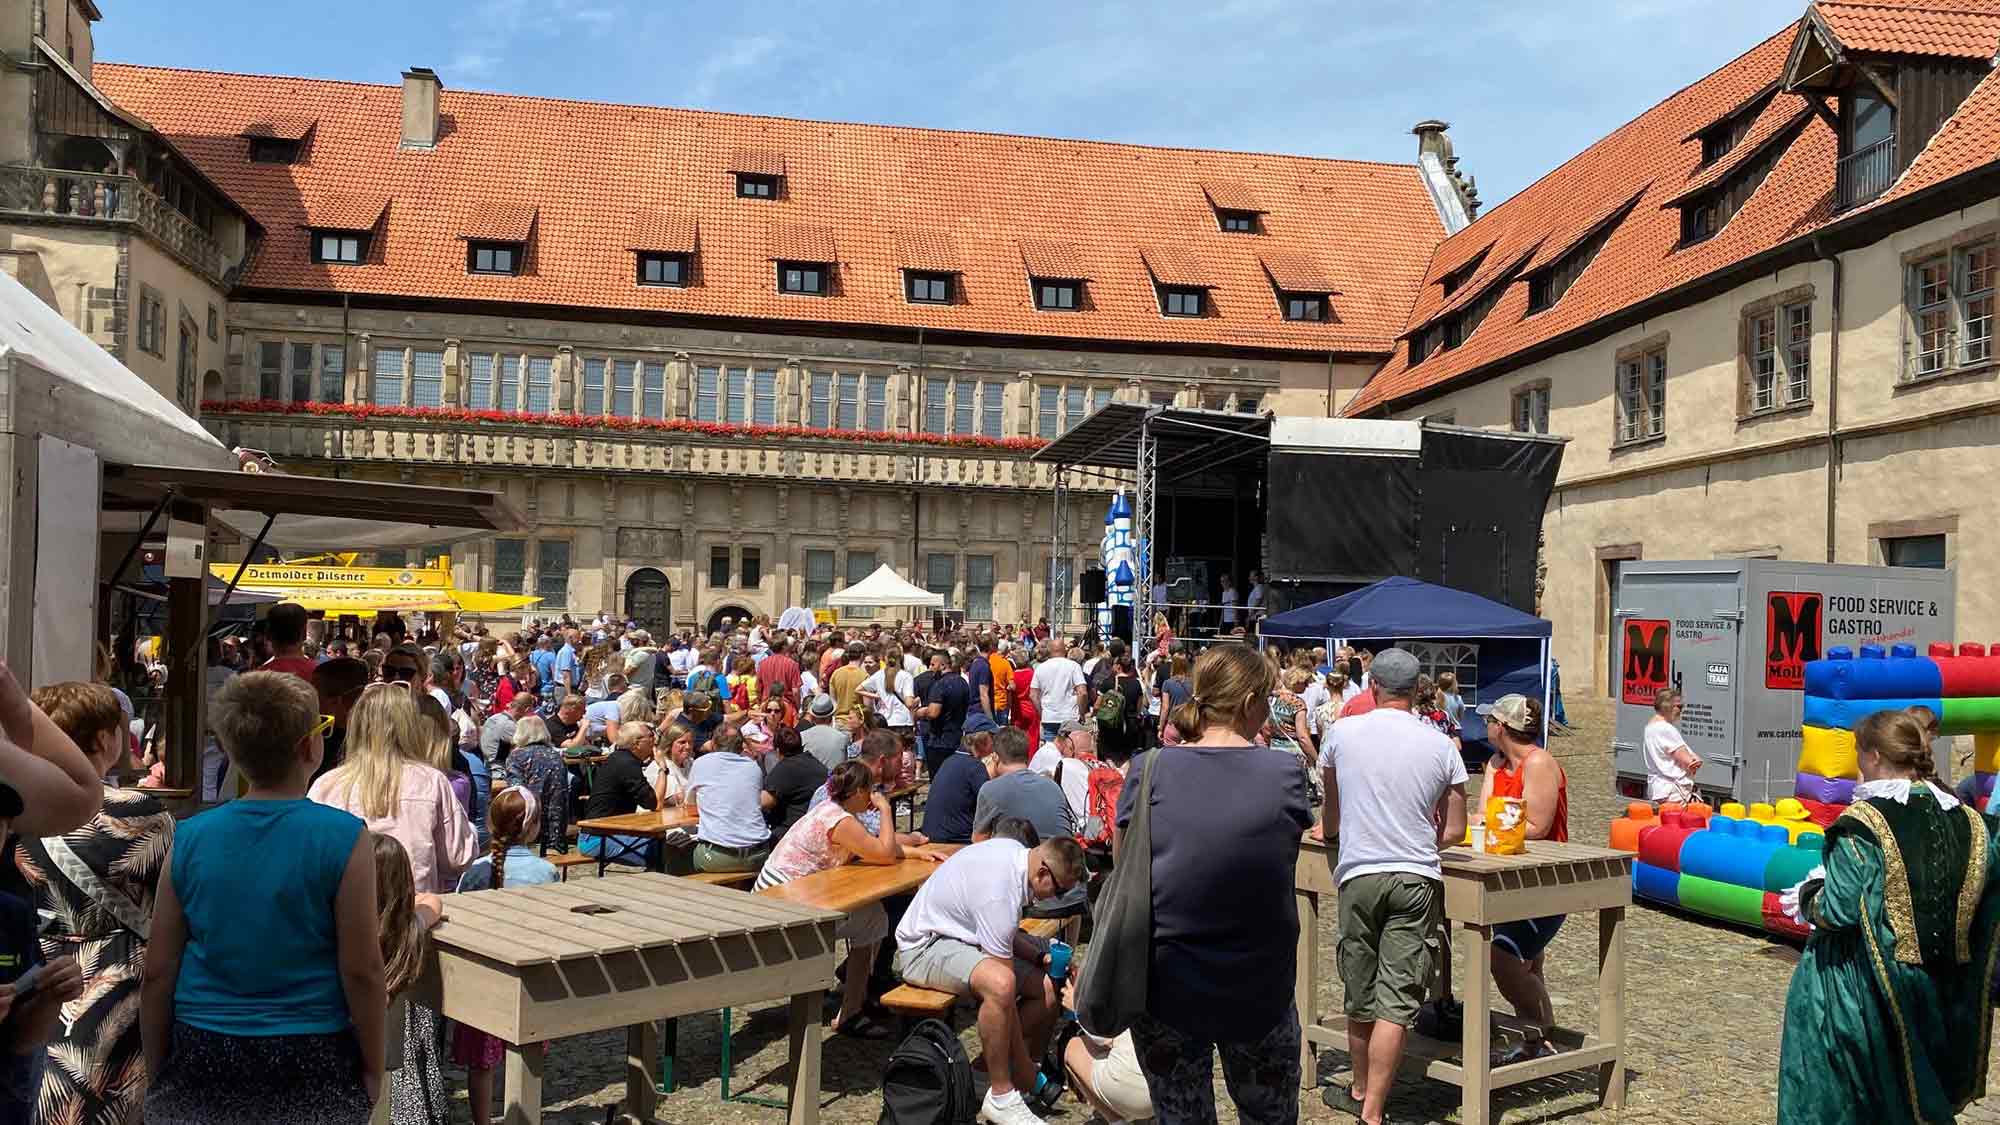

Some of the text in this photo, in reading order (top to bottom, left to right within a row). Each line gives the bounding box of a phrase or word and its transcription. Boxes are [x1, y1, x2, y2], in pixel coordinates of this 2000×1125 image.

[249, 569, 365, 582] Detmolder Pilsener
[1829, 597, 1938, 616] FOOD SERVICE &
[1676, 619, 1732, 630] FOOD SERVICE &
[1768, 596, 1820, 661] M
[1829, 619, 1882, 635] GASTRO
[1676, 630, 1703, 640] GASTRO
[1626, 625, 1668, 682] M
[1709, 665, 1728, 674] GAFA
[1709, 674, 1728, 683] TEAM
